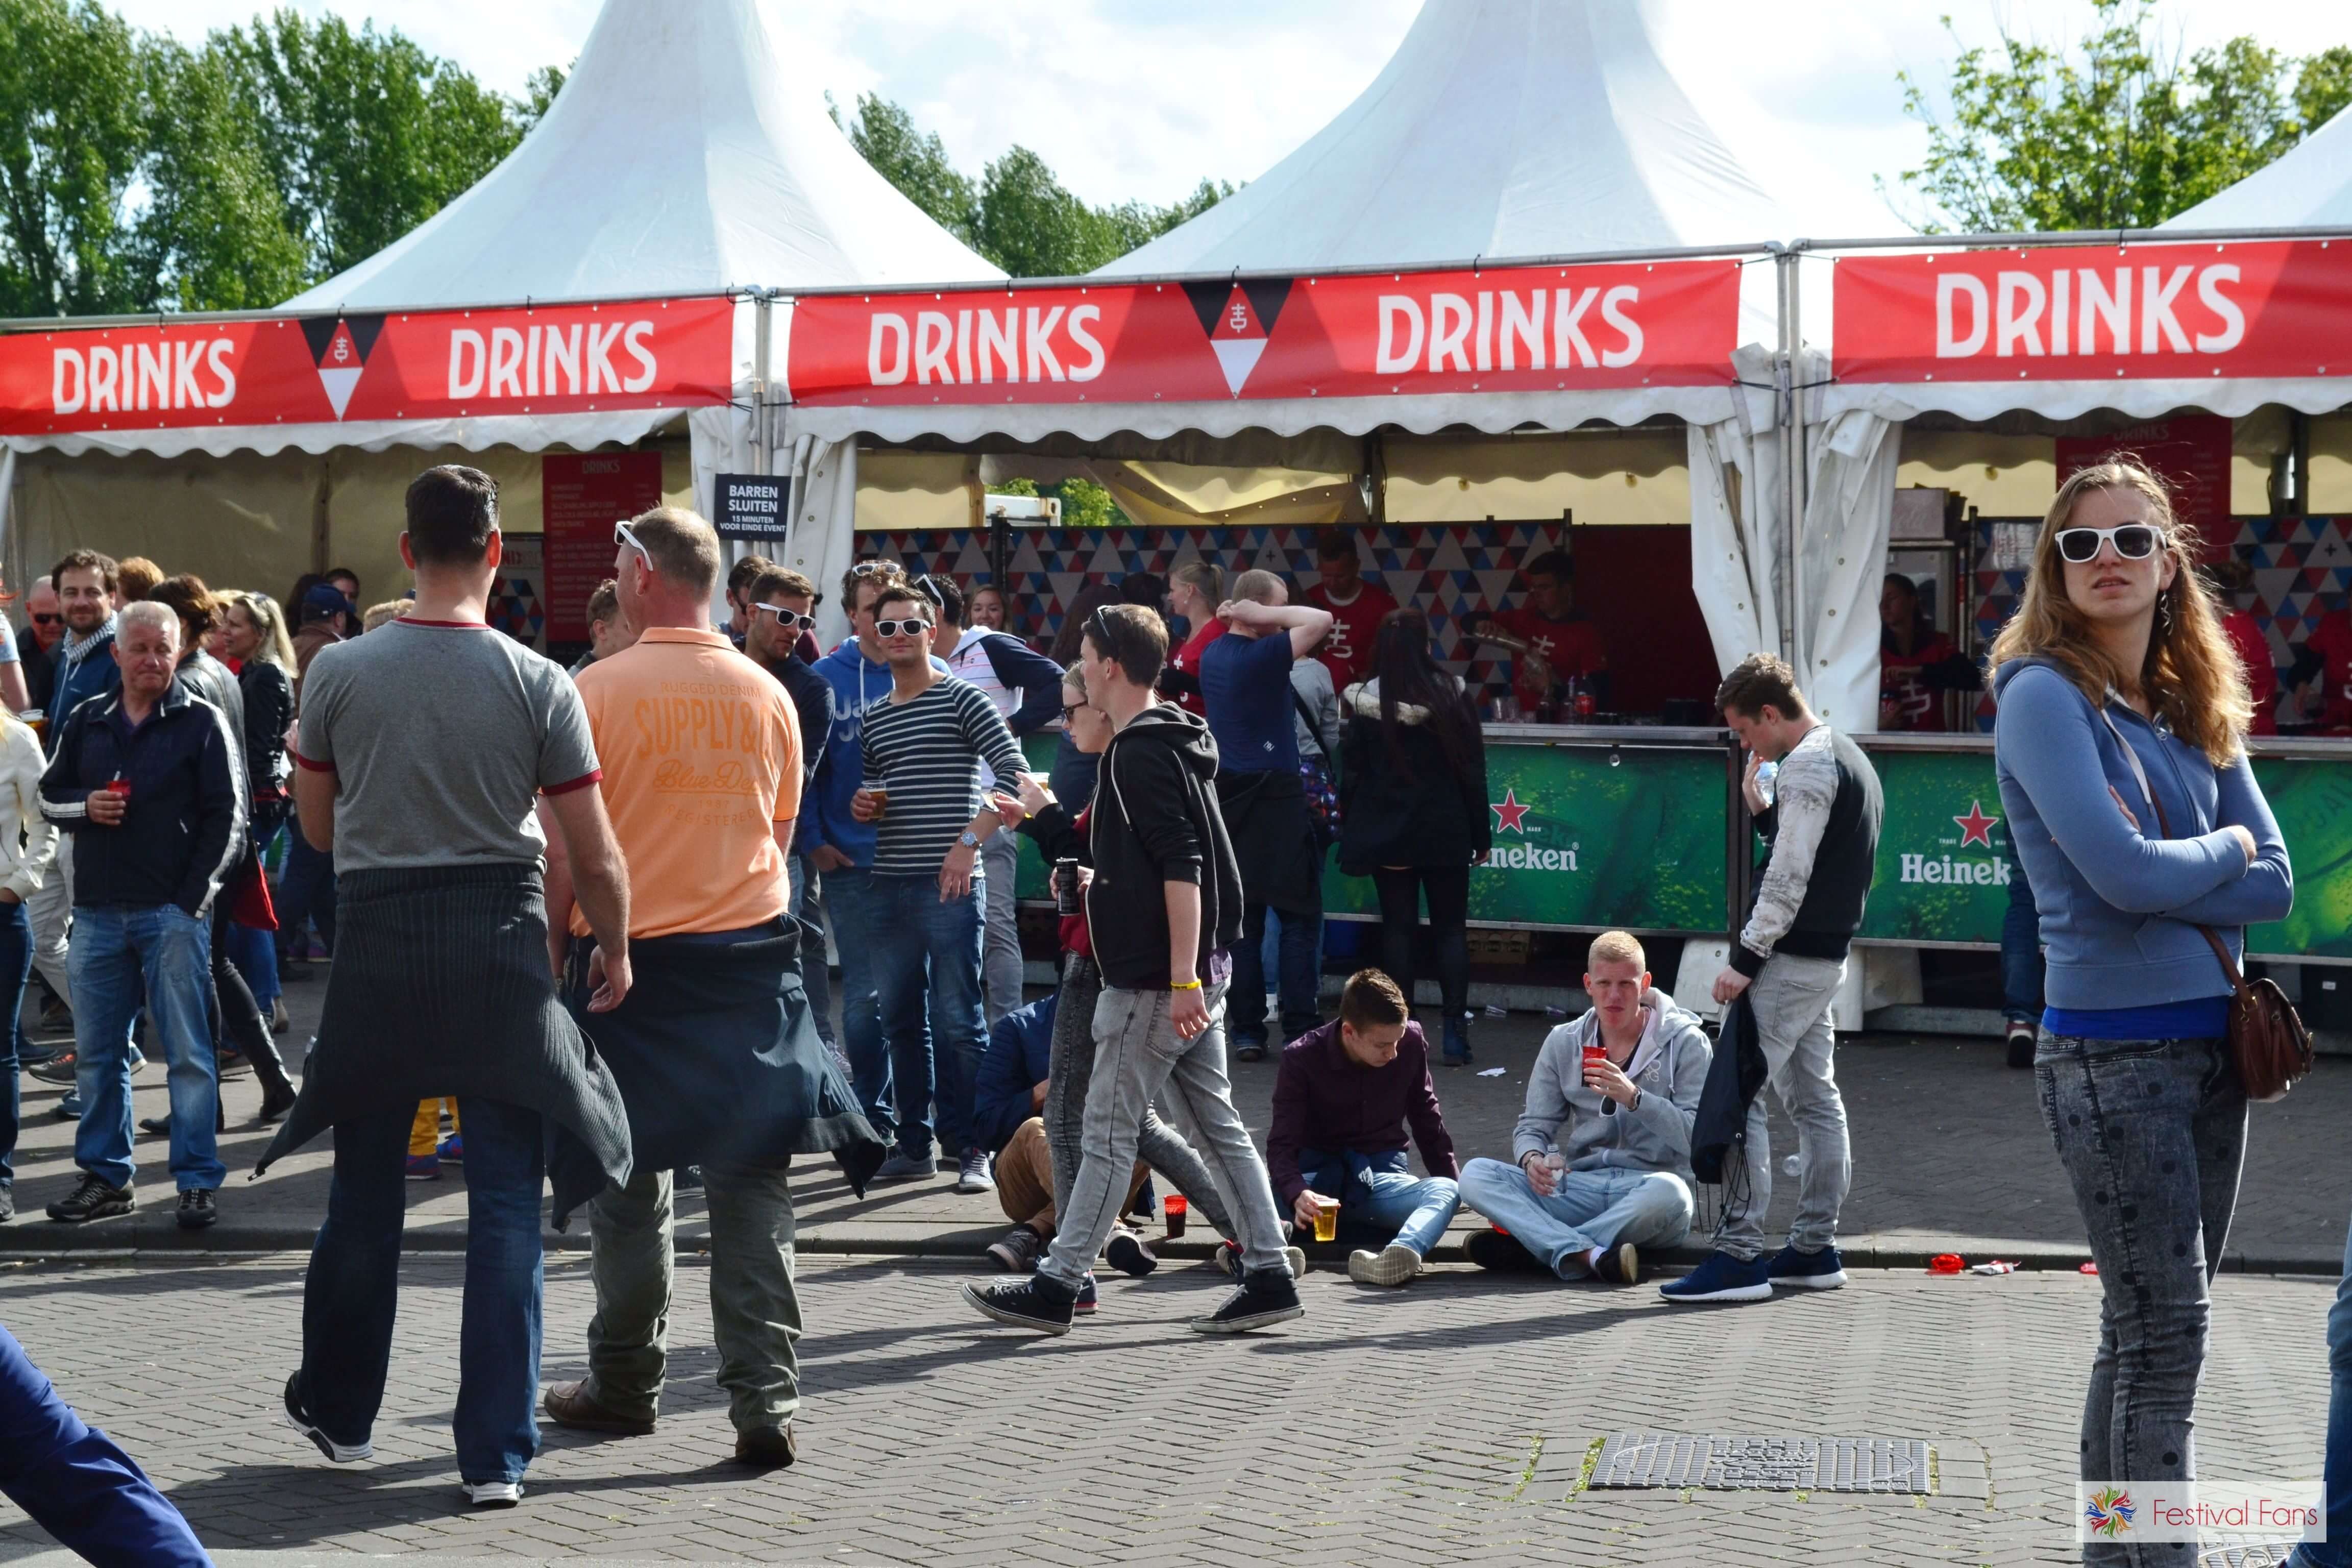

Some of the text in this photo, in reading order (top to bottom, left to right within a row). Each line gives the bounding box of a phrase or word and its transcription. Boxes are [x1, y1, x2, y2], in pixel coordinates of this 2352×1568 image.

[1936, 263, 2245, 358] DRINKS
[868, 304, 1105, 385] DRINKS
[1376, 285, 1644, 374] DRINKS
[449, 320, 657, 399] DRINKS
[53, 339, 235, 414] DRINKS
[582, 460, 620, 474] DRINKS
[728, 499, 778, 513] SLUITEN
[729, 485, 778, 498] BARREN
[742, 516, 774, 524] MINUTEN
[764, 524, 786, 532] EVENT
[660, 682, 760, 698] RUGGED DENIM
[653, 759, 711, 790] Blue
[1470, 842, 1578, 871] neken
[1900, 854, 2011, 886] Heinek
